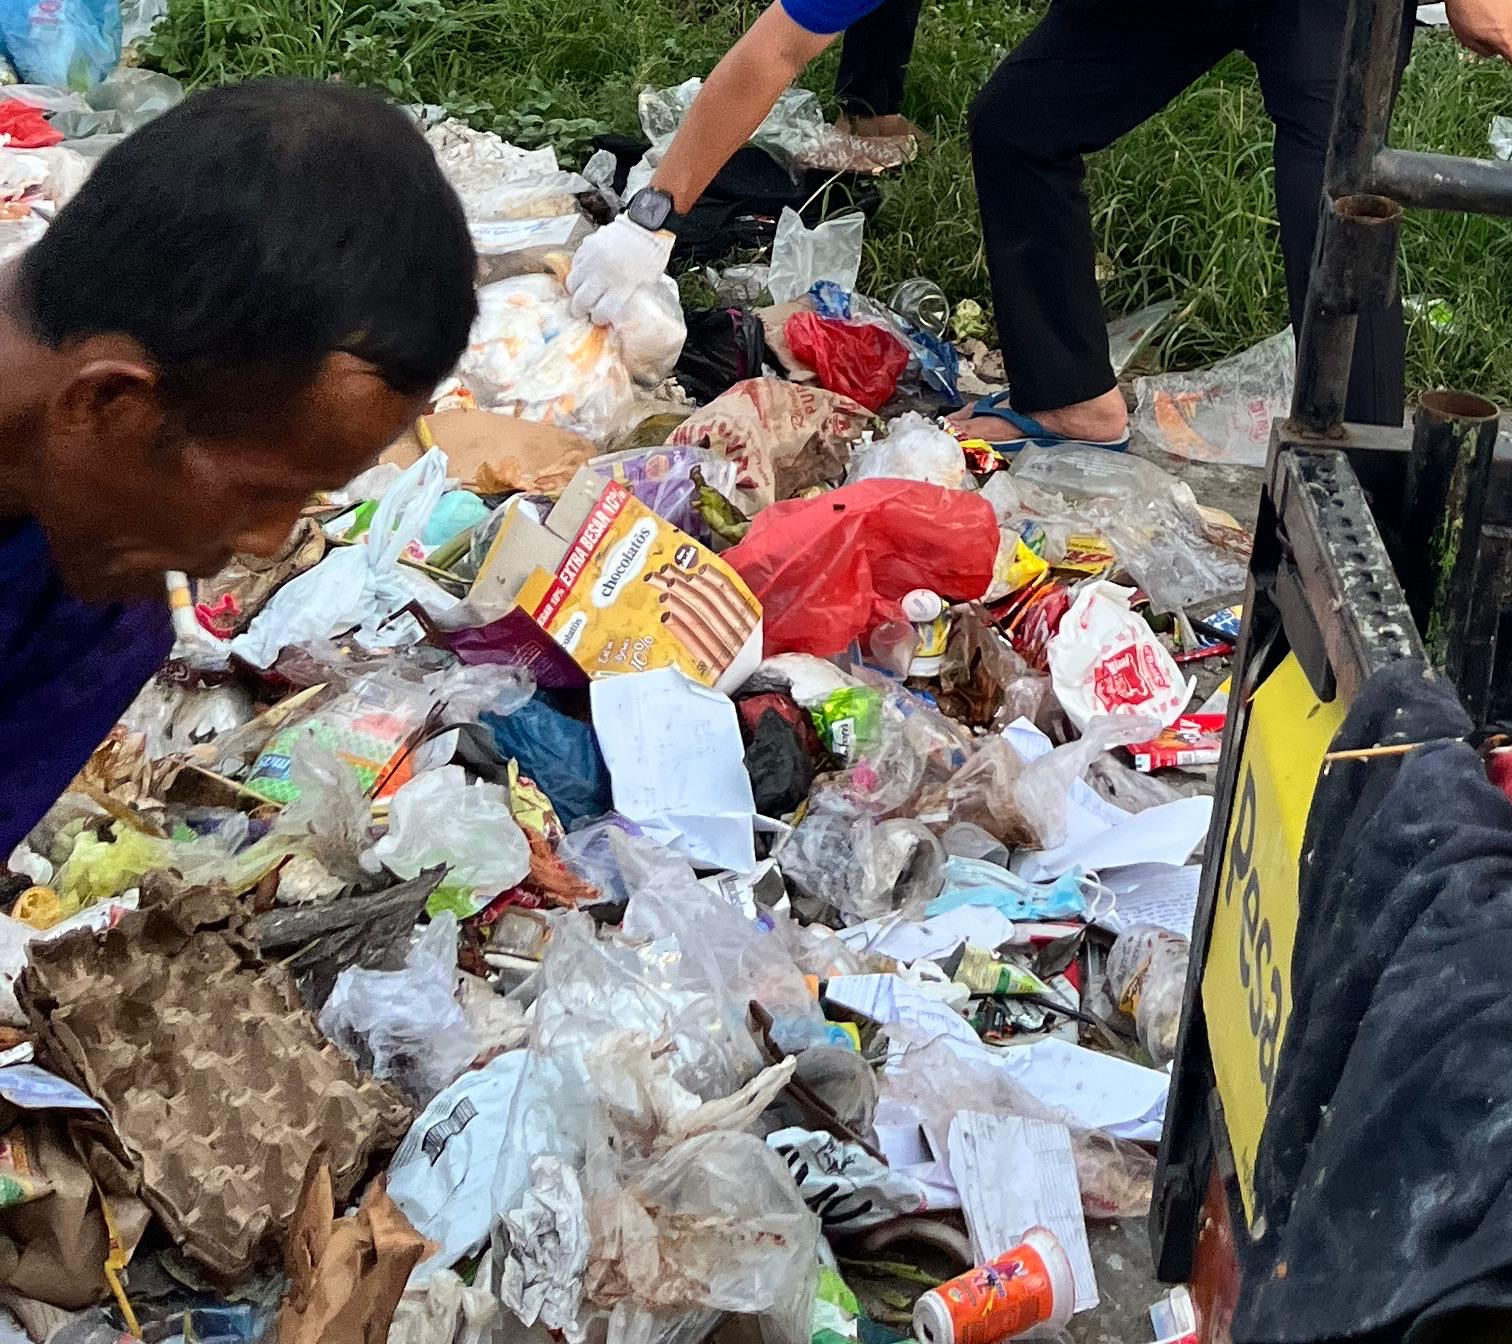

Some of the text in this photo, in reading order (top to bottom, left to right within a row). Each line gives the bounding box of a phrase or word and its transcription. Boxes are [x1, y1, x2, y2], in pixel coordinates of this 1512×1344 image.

[558, 487, 627, 589] EXTRA BESAR 10%
